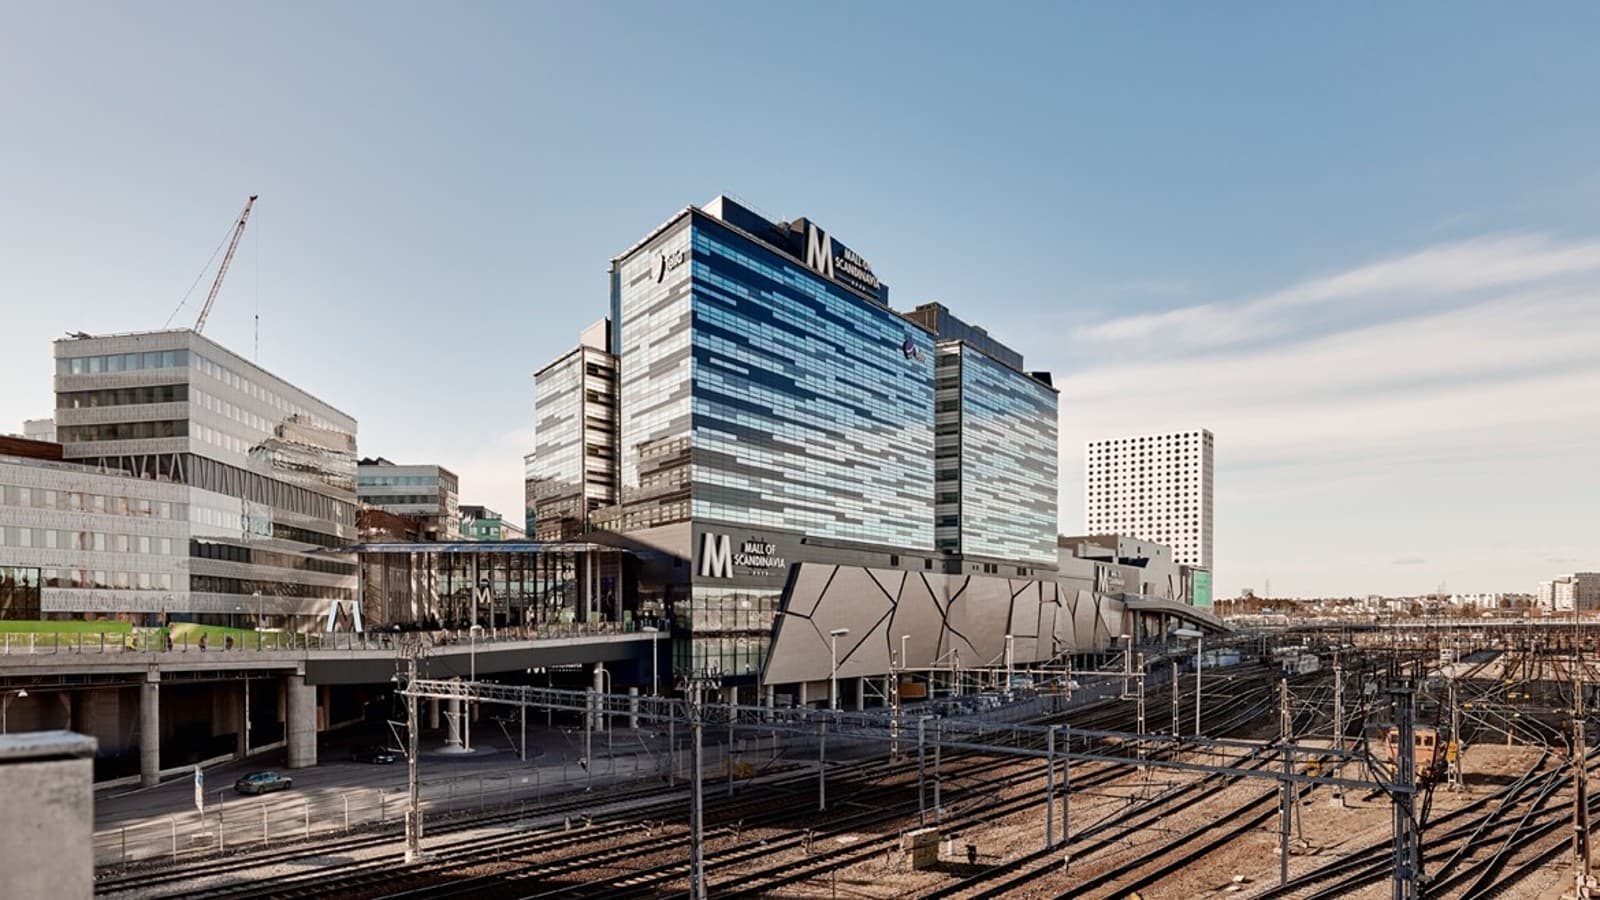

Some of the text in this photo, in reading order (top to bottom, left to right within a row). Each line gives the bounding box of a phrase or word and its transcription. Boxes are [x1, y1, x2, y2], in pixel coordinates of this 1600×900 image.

[807, 223, 835, 279] M
[844, 248, 862, 267] MALL
[835, 256, 881, 290] SCANDINAVIA
[702, 532, 733, 578] M
[734, 554, 786, 569] SCANDINAVIA
[744, 543, 776, 555] MALL OF
